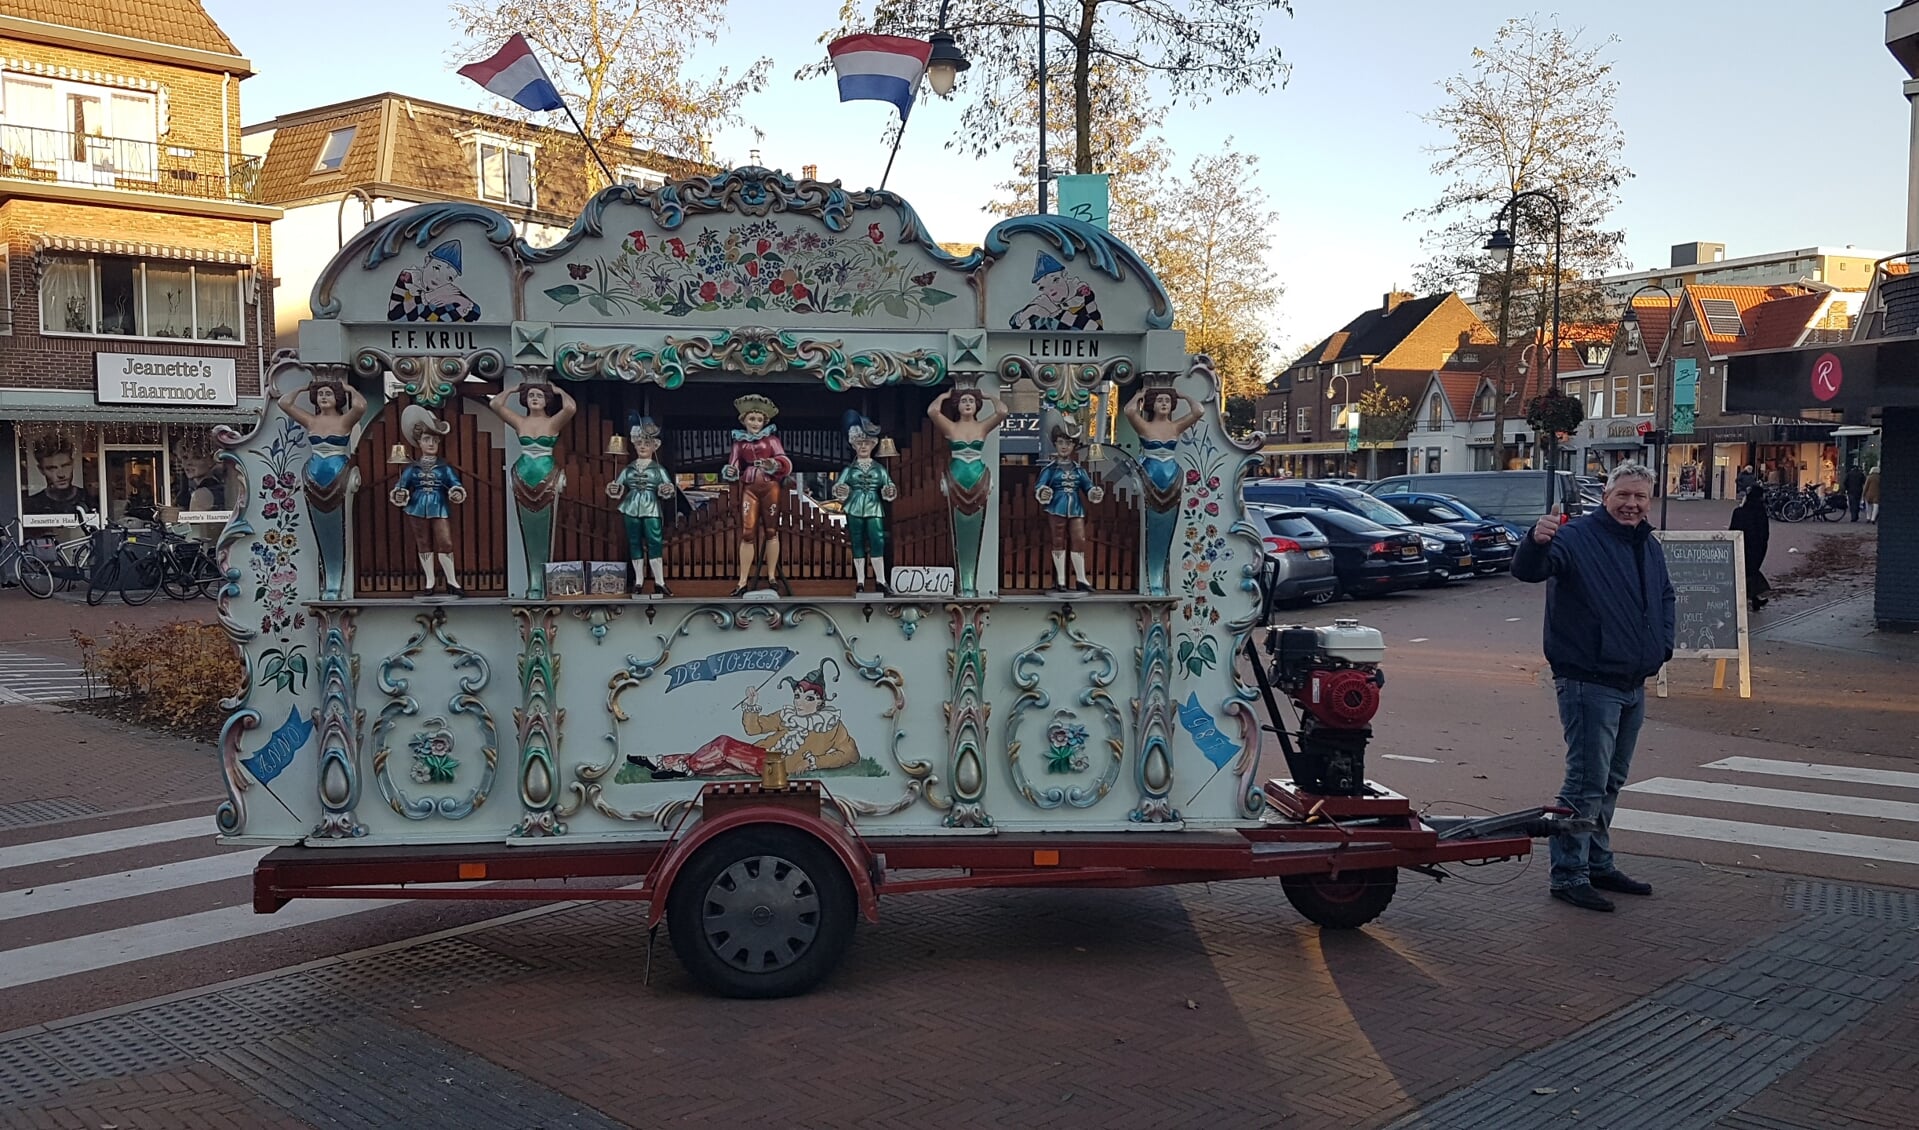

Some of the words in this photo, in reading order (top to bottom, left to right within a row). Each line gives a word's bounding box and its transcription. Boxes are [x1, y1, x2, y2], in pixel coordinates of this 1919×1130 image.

[392, 331, 402, 349] F.
[408, 331, 418, 349] F.
[426, 331, 478, 349] KRUL
[1029, 339, 1099, 357] LEIDEN
[122, 358, 212, 378] Jeanette's
[1817, 360, 1836, 391] R
[120, 381, 217, 401] Haarmode
[672, 661, 701, 687] DE
[714, 649, 785, 674] JOKER
[259, 726, 300, 779] ANNO
